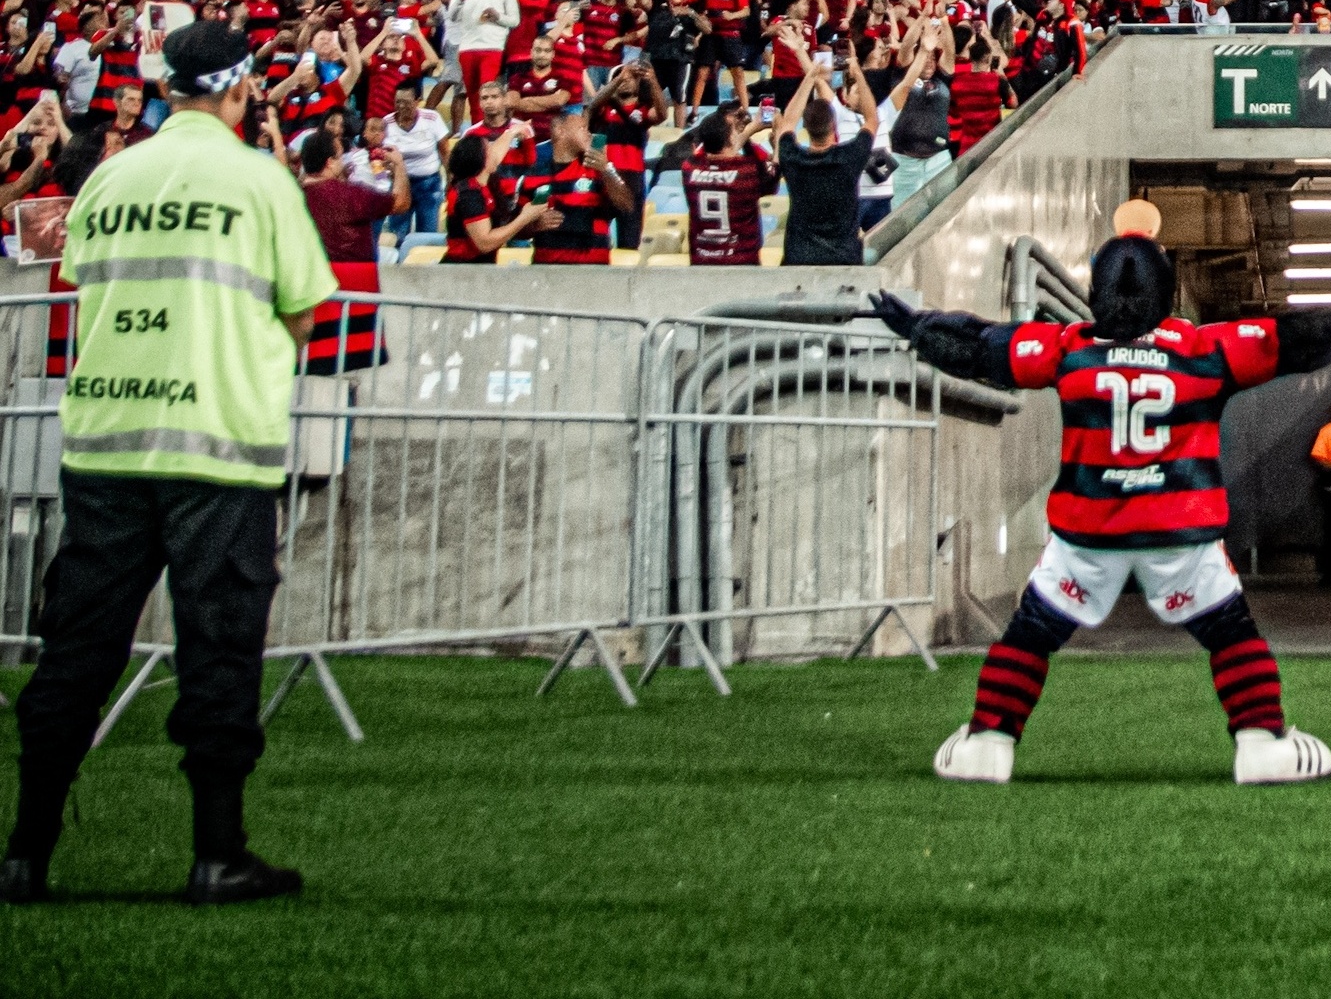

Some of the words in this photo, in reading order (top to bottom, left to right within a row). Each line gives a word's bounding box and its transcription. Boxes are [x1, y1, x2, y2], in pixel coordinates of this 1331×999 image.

[1221, 68, 1258, 114] T
[1249, 103, 1291, 115] NORTE
[690, 169, 738, 183] MRV
[86, 201, 243, 240] SUNSET
[699, 190, 731, 235] 9
[115, 307, 169, 333] 534
[1095, 371, 1177, 455] 12
